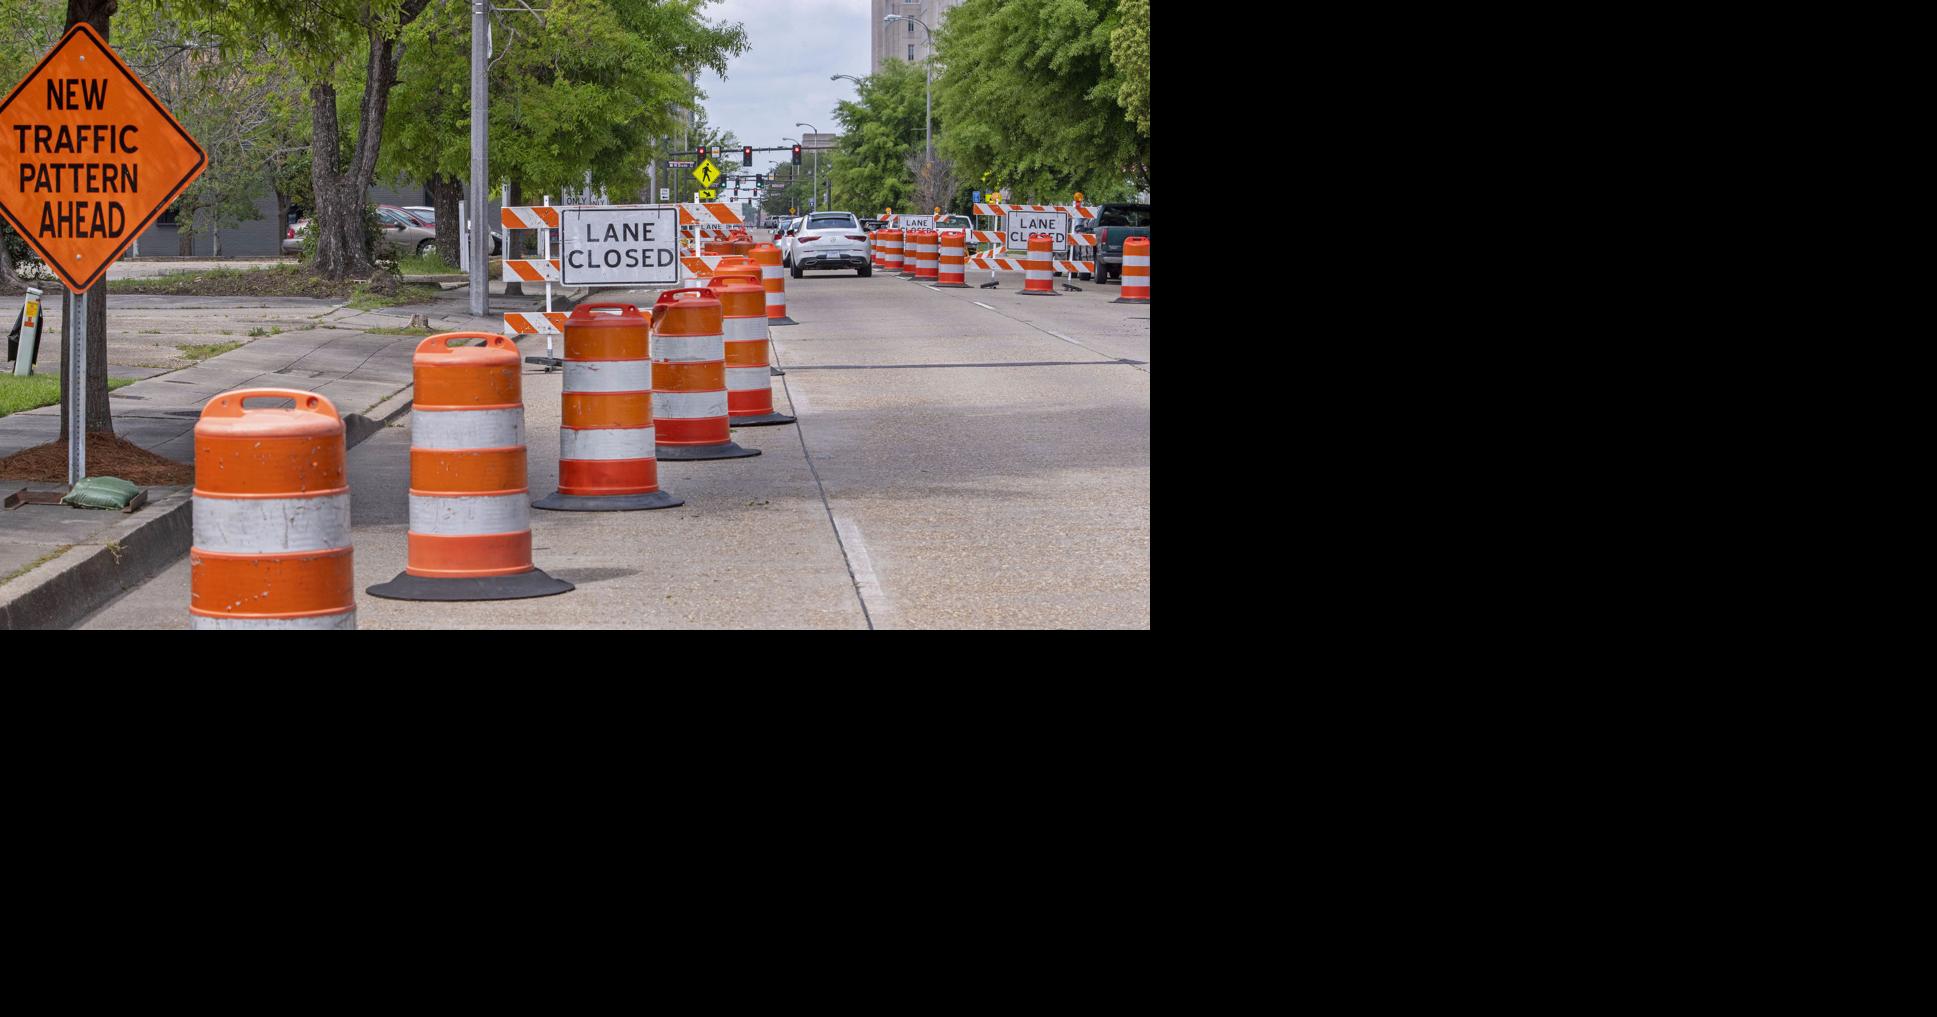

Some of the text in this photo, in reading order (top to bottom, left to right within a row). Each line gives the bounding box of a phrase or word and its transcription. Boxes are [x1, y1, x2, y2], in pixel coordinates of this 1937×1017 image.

[47, 79, 108, 110] NEW
[14, 125, 139, 154] TRAFFIC
[19, 163, 138, 193] PATTERN
[567, 197, 586, 206] ONLY
[39, 201, 125, 239] AHEAD
[906, 219, 928, 227] LANE
[1020, 218, 1056, 230] LANE
[587, 222, 656, 243] LANE
[568, 248, 674, 269] CLOSED
